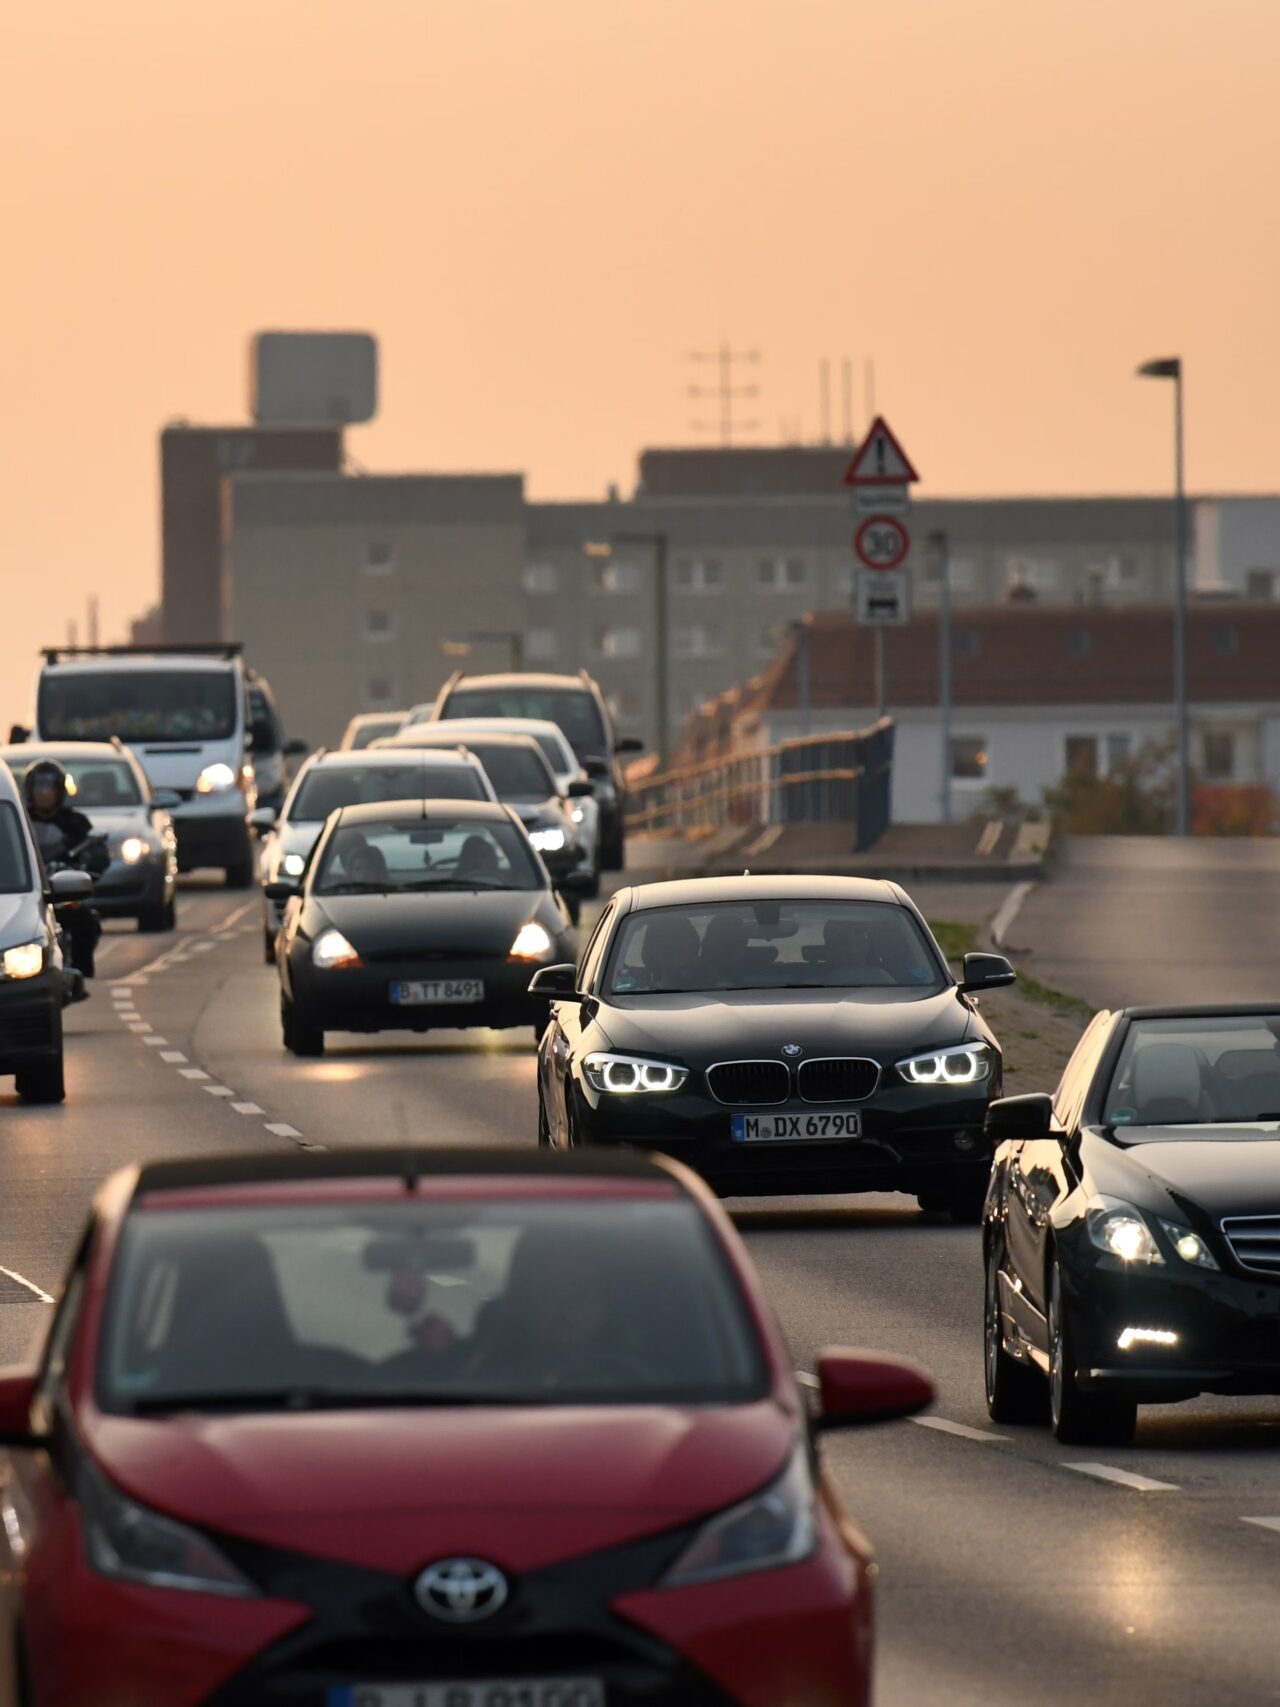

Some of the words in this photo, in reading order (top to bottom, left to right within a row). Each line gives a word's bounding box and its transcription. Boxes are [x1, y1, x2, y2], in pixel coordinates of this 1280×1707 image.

[867, 529, 900, 557] 30
[401, 983, 410, 999] B
[421, 982, 440, 998] TT
[444, 981, 482, 998] 8491
[746, 1118, 759, 1138] M
[773, 1116, 801, 1137] DX
[806, 1114, 858, 1136] 6790
